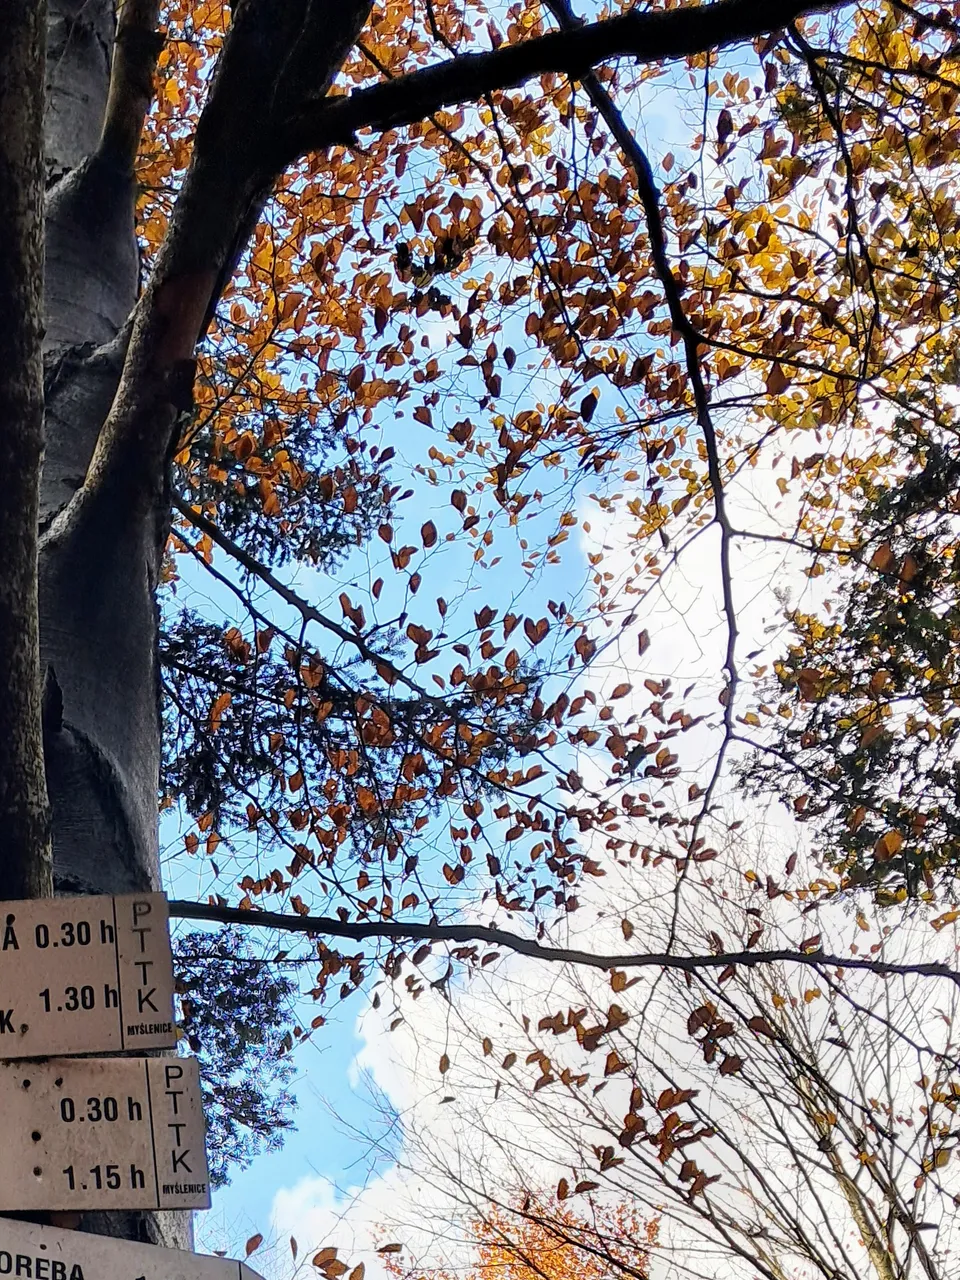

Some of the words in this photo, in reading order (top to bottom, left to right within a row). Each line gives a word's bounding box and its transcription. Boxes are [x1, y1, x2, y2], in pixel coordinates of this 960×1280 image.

[35, 921, 91, 949] 0.30
[100, 918, 115, 945] h
[39, 985, 95, 1013] 1.30
[104, 982, 119, 1009] h
[126, 1021, 173, 1037] MYŚLENICE
[60, 1096, 118, 1123] 0.30
[128, 1096, 142, 1122] h
[62, 1164, 121, 1191] 1.15
[130, 1164, 145, 1189] h
